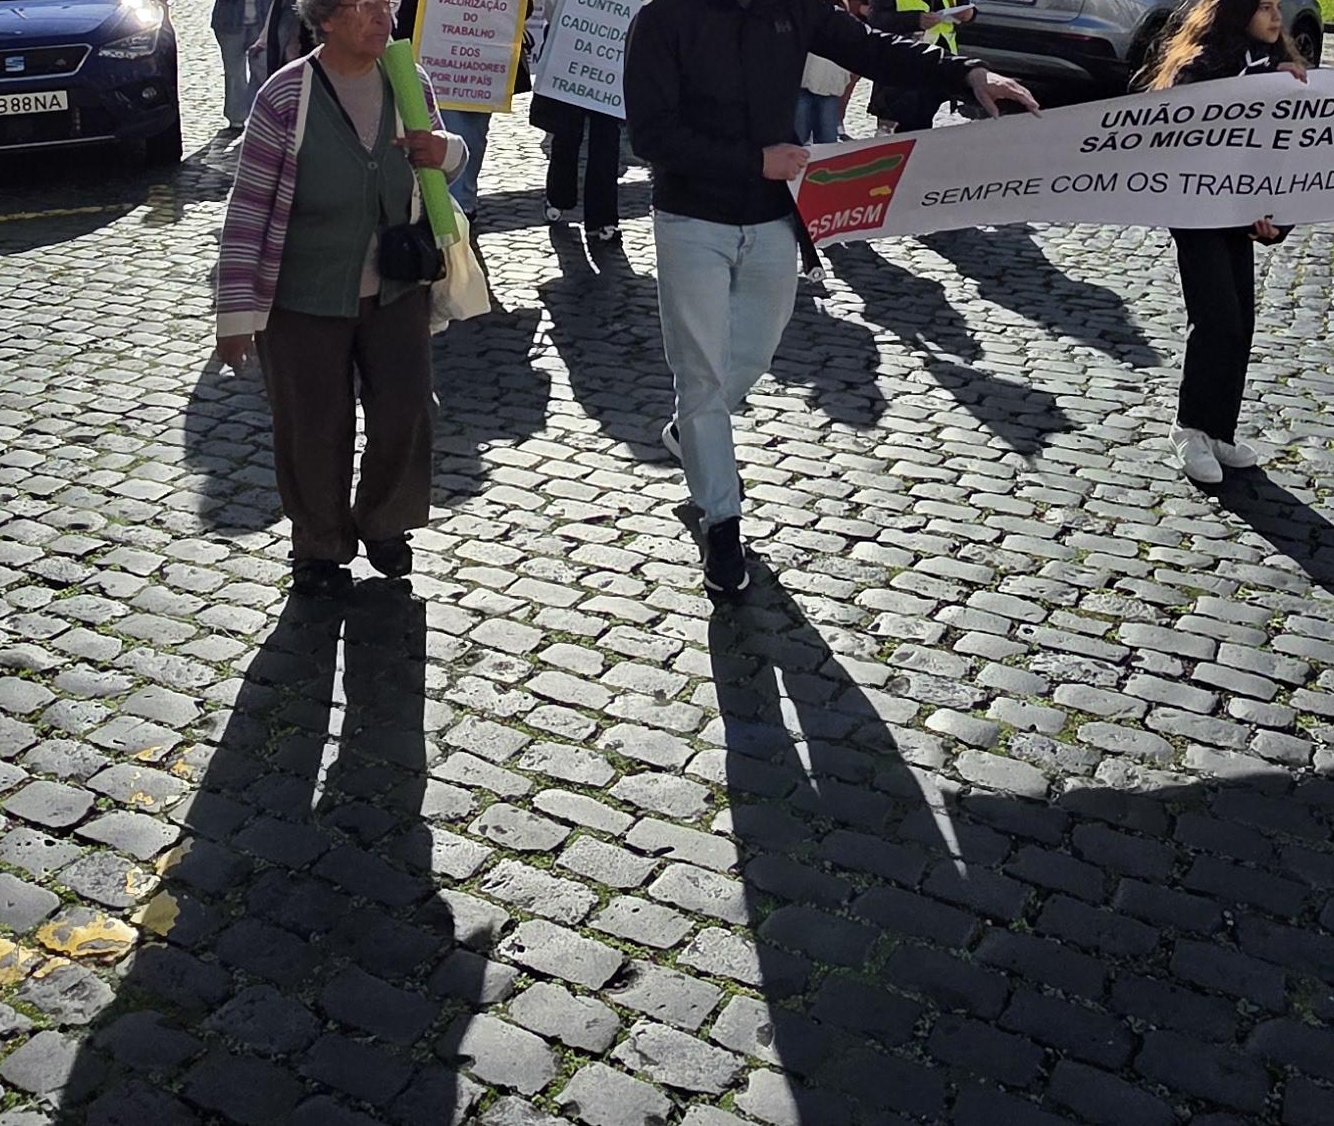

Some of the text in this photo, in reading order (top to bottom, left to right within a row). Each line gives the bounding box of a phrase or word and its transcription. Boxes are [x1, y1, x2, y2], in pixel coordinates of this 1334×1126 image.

[463, 12, 478, 23] DO
[442, 24, 495, 39] TRABALHO
[451, 45, 480, 58] E DOS
[574, 38, 624, 62] DA CCT
[421, 56, 506, 73] TRABALHADORES
[568, 61, 616, 85] E PELO
[430, 72, 451, 82] POR
[453, 74, 467, 84] UM
[452, 87, 491, 99] FUTURO
[552, 76, 622, 107] TRABALHO
[1101, 103, 1195, 128] UNIÃO
[1202, 102, 1265, 122] DOS
[1079, 131, 1142, 153] SÃO
[1149, 127, 1262, 148] MIGUEL
[1272, 129, 1293, 150] E
[921, 177, 1043, 206] SEMPRE
[1050, 173, 1118, 193] COM
[1127, 172, 1169, 193] OS
[807, 202, 883, 240] SSMSM
